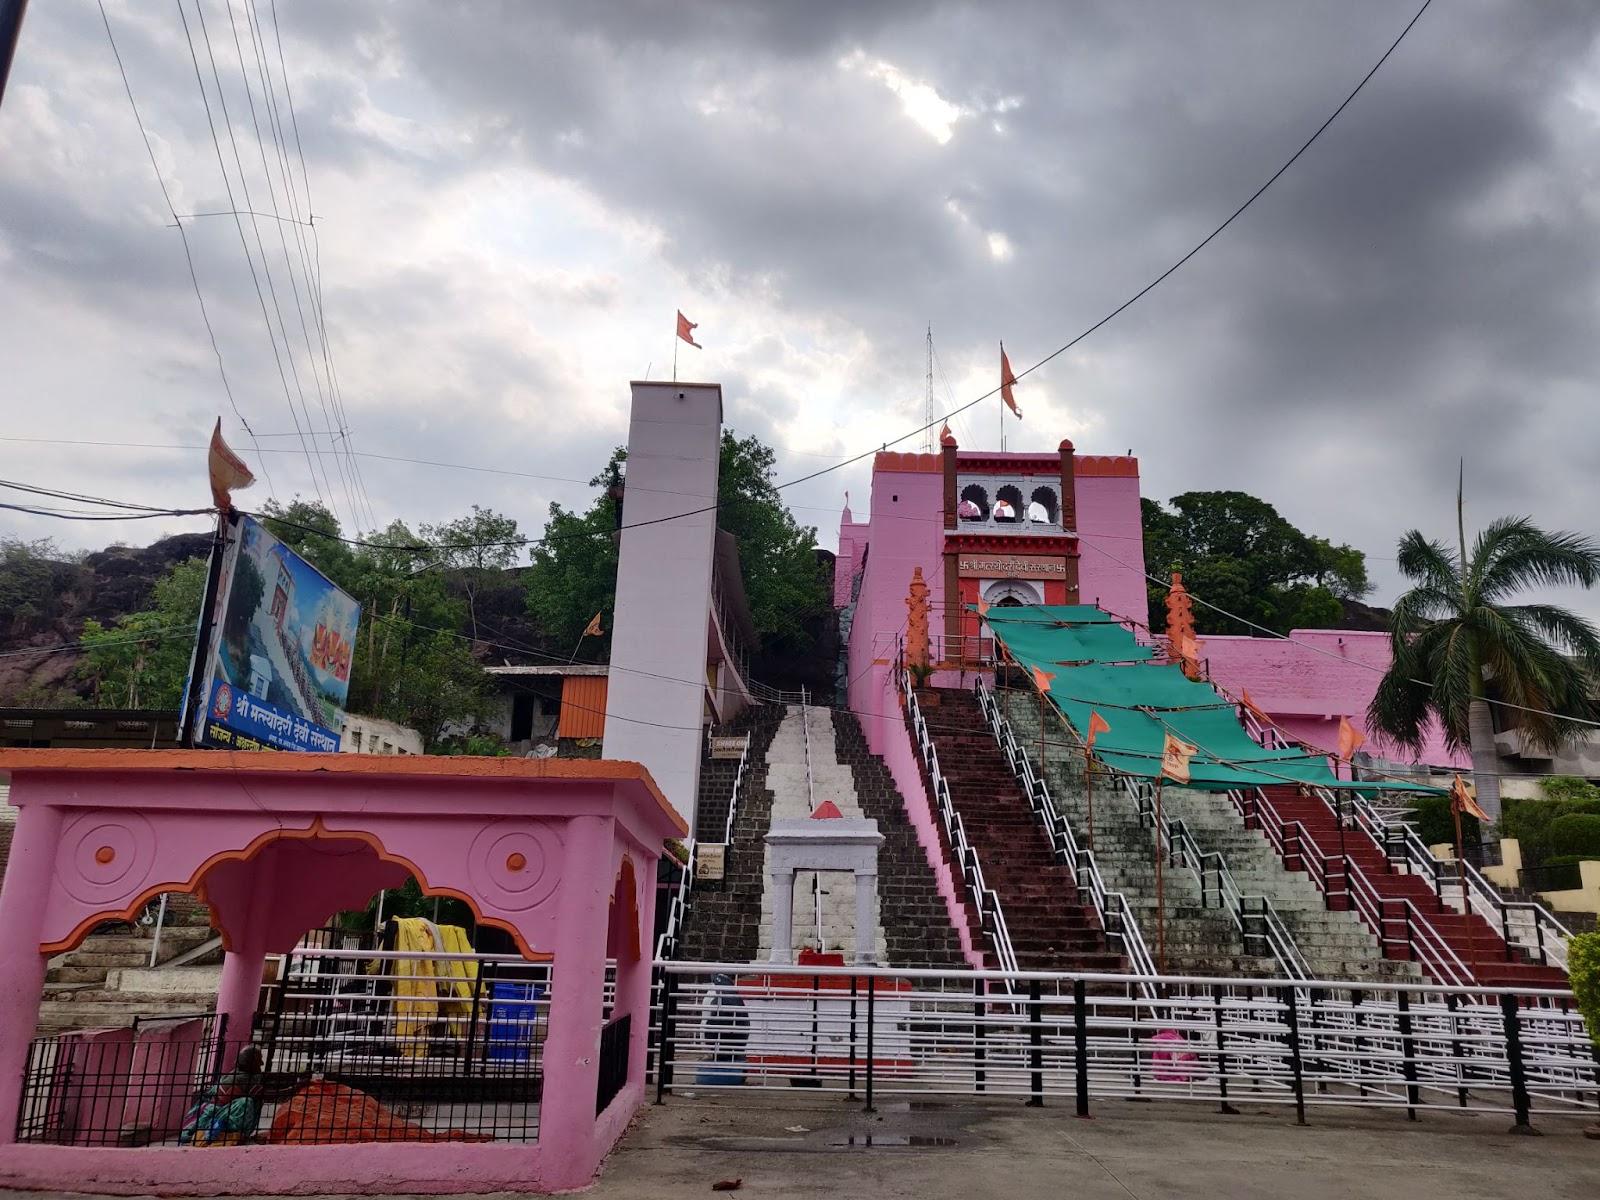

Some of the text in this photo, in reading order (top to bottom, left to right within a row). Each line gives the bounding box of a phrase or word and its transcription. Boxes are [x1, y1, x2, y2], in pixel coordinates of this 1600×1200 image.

[237, 695, 249, 717] श्री
[251, 704, 292, 734] मत्स्योदरी
[294, 718, 309, 742] देवी
[311, 727, 336, 752] संस्थान
